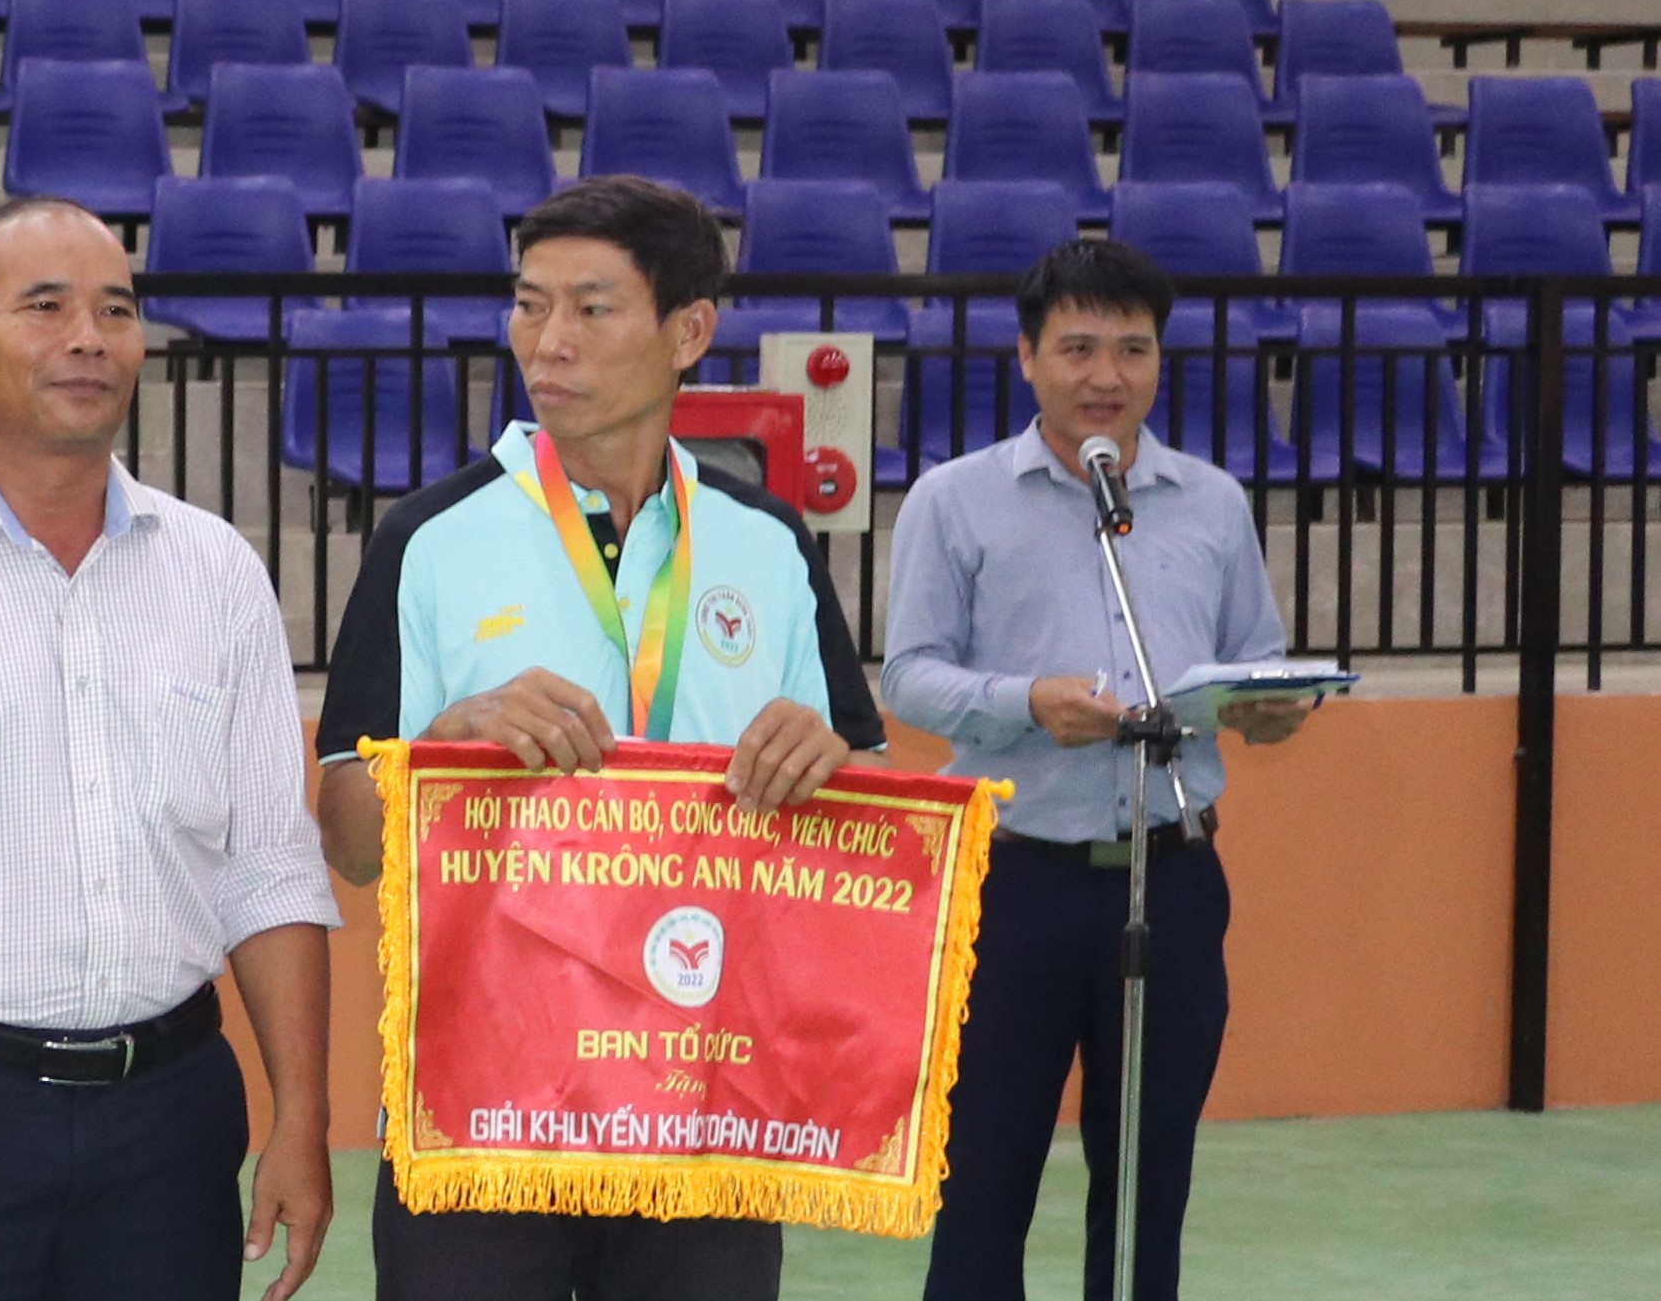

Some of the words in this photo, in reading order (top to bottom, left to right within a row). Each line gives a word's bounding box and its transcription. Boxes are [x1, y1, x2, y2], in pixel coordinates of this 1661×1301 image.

[464, 787, 501, 840] HỘI
[507, 796, 571, 831] THAO
[577, 789, 624, 832] CÁN
[629, 790, 664, 844] BỘ,
[670, 791, 723, 836] CÔNG
[791, 808, 835, 850] VIÊN
[838, 814, 897, 858] CHỨC
[440, 840, 552, 893] HUYỆN
[561, 843, 684, 888] KRÔNG
[751, 855, 825, 901] NĂM
[831, 870, 914, 913] 2022
[577, 1029, 648, 1060] BAN
[658, 1022, 702, 1063] TỔ
[469, 1100, 523, 1142] GIẢI
[529, 1103, 650, 1147] KHUYẾN
[764, 1118, 840, 1160] ĐOÀN
